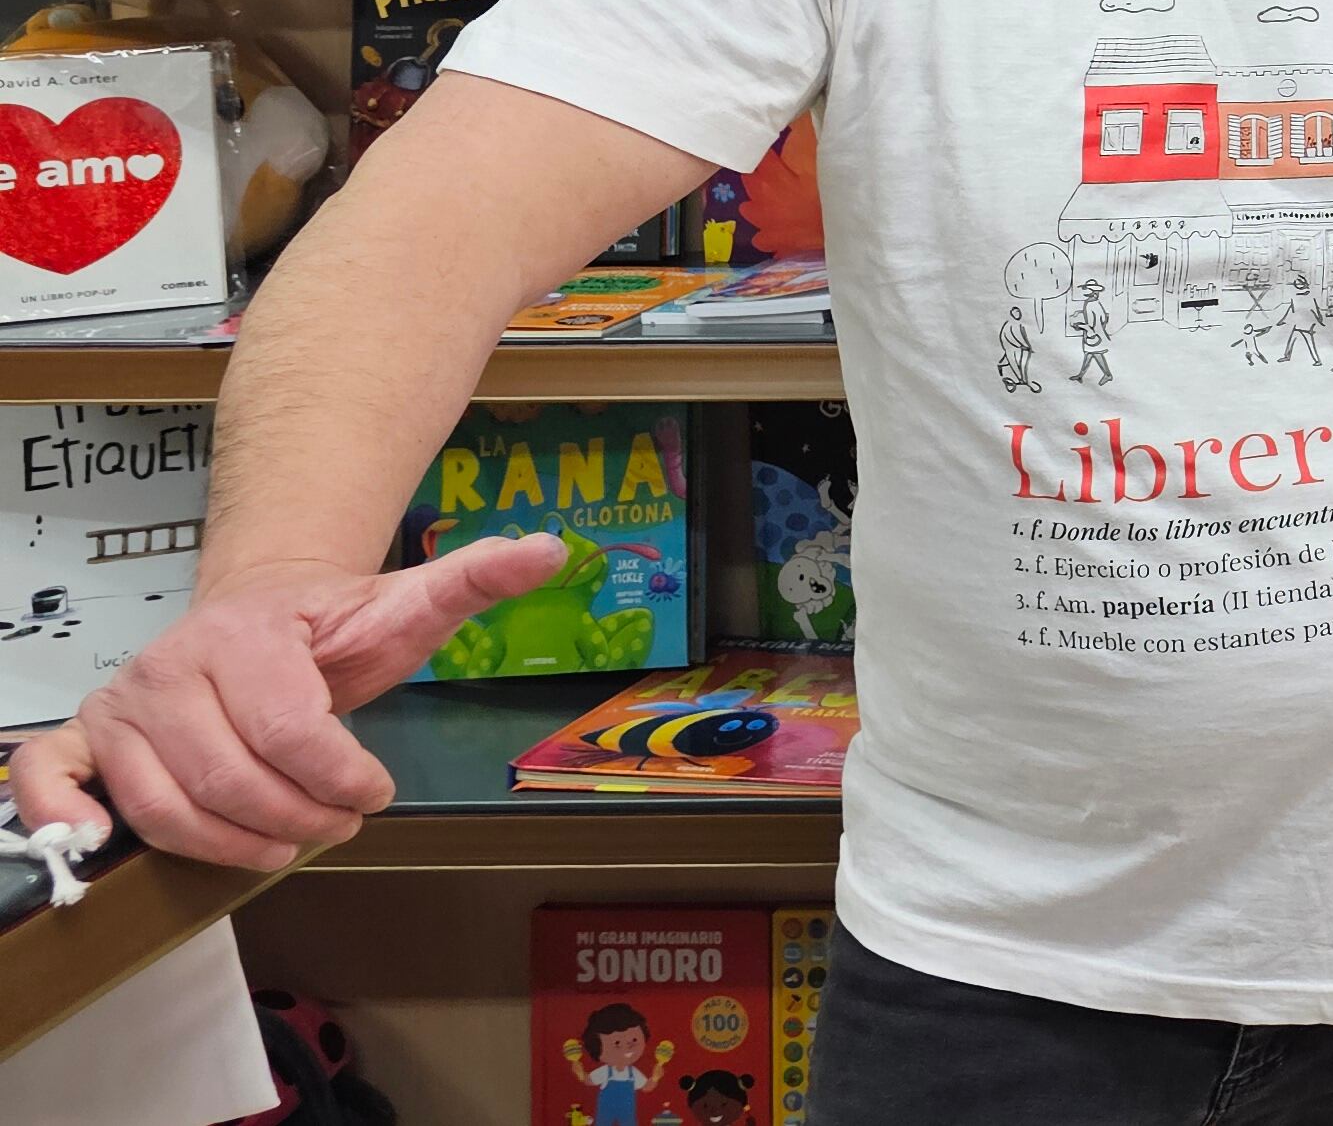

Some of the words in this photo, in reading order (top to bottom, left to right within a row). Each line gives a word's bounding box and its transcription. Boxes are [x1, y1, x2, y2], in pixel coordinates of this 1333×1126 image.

[46, 76, 65, 88] A.
[70, 72, 118, 88] Carter
[1109, 220, 1185, 230] LIBROS
[20, 294, 34, 304] UN
[38, 291, 72, 302] LIBRO
[76, 288, 118, 298] POP-UP
[479, 436, 506, 457] LA
[441, 432, 668, 513] RANA
[573, 502, 673, 526] GLOTONA
[1050, 521, 1121, 541] Donde
[1128, 523, 1158, 542] los
[1166, 519, 1231, 540] libros
[616, 559, 640, 571] JACK
[1055, 557, 1150, 580] Ejercicio
[1157, 564, 1171, 578] o
[1179, 546, 1292, 582] profesión
[1299, 545, 1326, 564] de
[612, 572, 643, 584] TICKLE
[1054, 596, 1096, 614] Am.
[1103, 592, 1215, 620] papelería
[1223, 592, 1249, 615] (II
[1059, 629, 1137, 653] Mueble
[1143, 636, 1186, 653] con
[1194, 626, 1296, 653] estantes
[576, 932, 594, 944] MI
[599, 932, 638, 944] GRAN
[641, 931, 723, 944] IMAGINARIO
[577, 948, 723, 983] SONORO
[702, 1014, 740, 1032] 100
